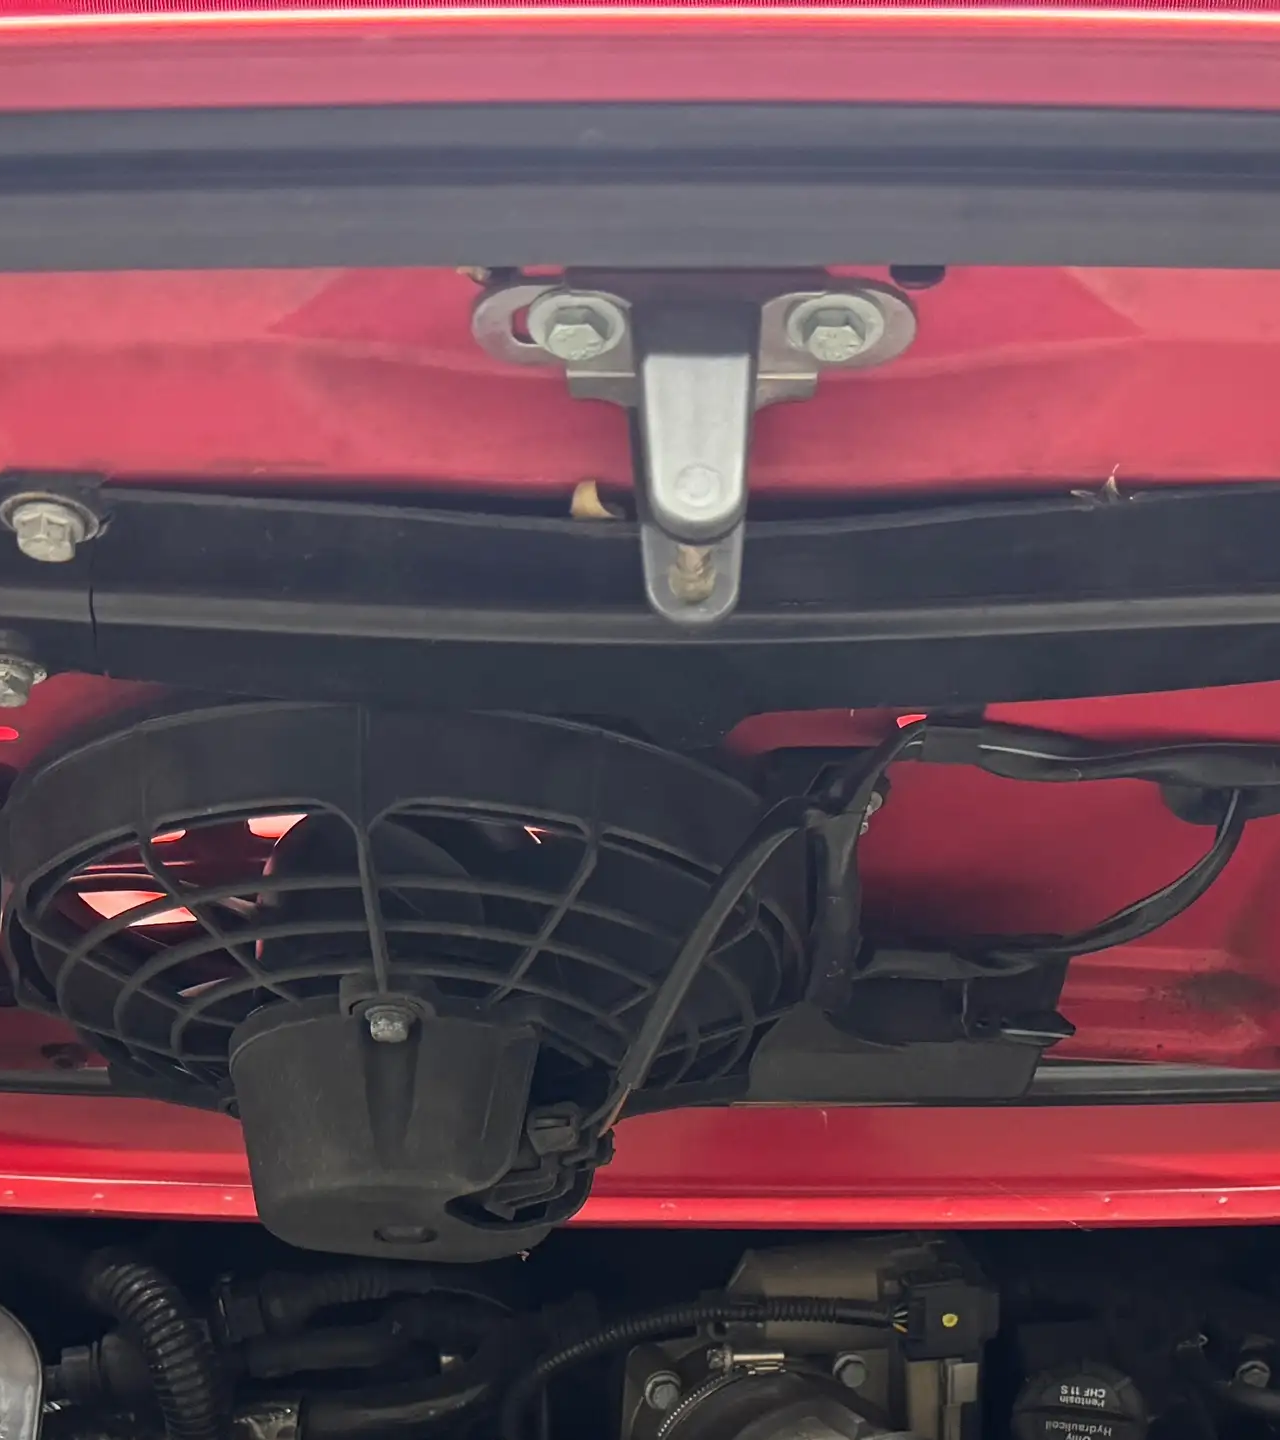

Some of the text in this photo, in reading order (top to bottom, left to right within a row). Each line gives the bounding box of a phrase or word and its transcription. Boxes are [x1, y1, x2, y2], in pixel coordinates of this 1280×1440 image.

[1060, 1384, 1107, 1399] CHF 11 S
[1045, 1420, 1112, 1437] Hydraulicoil
